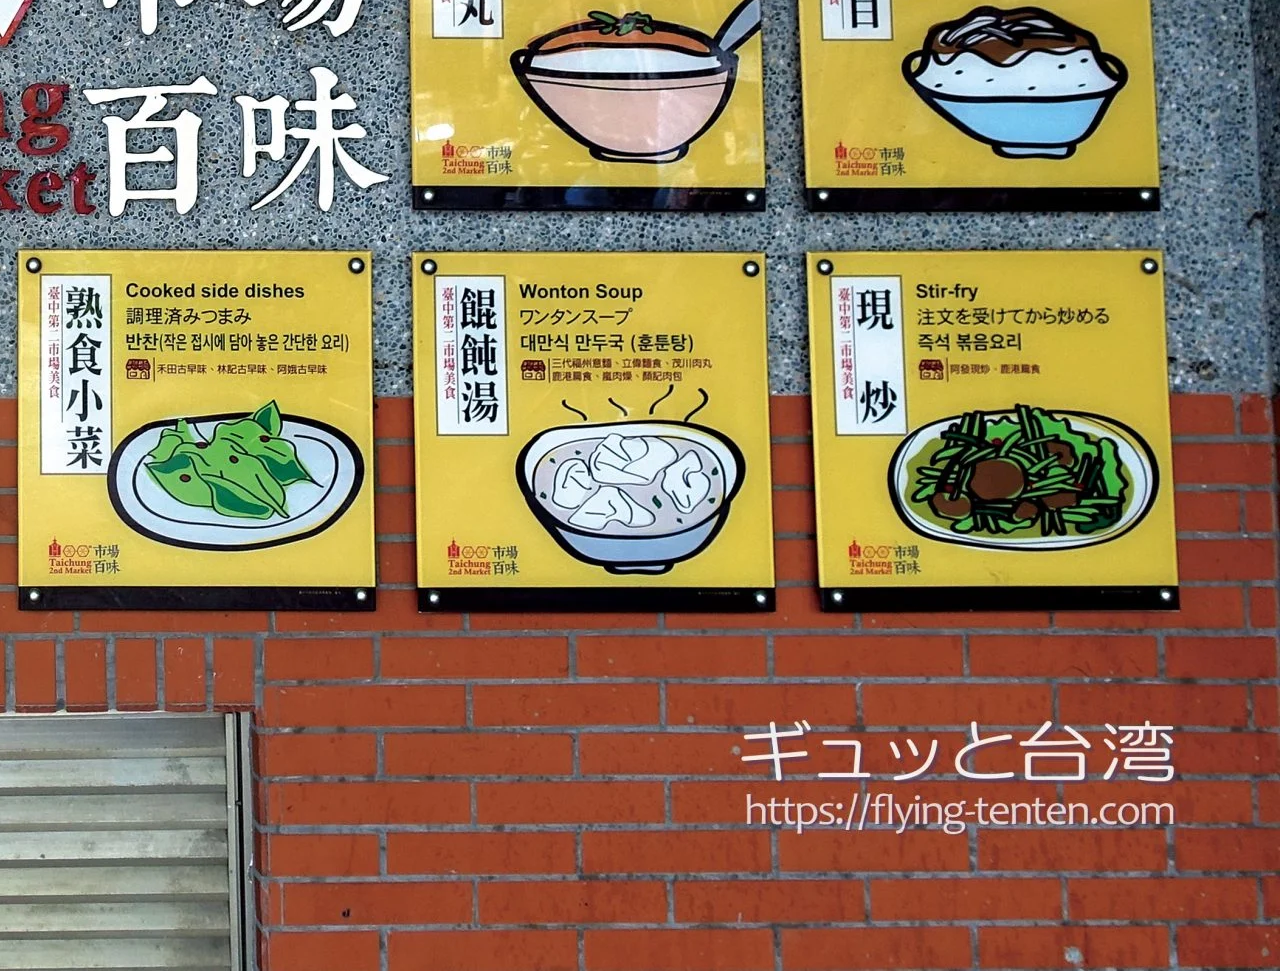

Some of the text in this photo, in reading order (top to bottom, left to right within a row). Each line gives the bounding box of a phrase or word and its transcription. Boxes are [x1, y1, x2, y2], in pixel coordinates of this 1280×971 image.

[82, 66, 390, 218] 百味
[126, 283, 305, 298] Cooked side dishes
[520, 284, 643, 301] Wonton Soup
[916, 284, 978, 301] Stir-fry
[126, 307, 252, 325] 調理済みつまみ
[520, 308, 632, 325] ワンタンスープ
[918, 308, 1110, 326] 注文を受けてから炒める
[126, 333, 350, 352] 반찬(작은 접시에 담아 놓은 간단한 요리)
[521, 334, 693, 353] 대만식 만두국 (훈툰탕)
[918, 333, 1022, 351] 즉석 볶음요리
[461, 287, 498, 423] 餛飩湯
[857, 289, 897, 424] 現炒
[66, 287, 103, 469] 熟食小菜
[94, 545, 119, 558] 市場
[49, 559, 92, 568] Taichung
[94, 560, 120, 574] 百味
